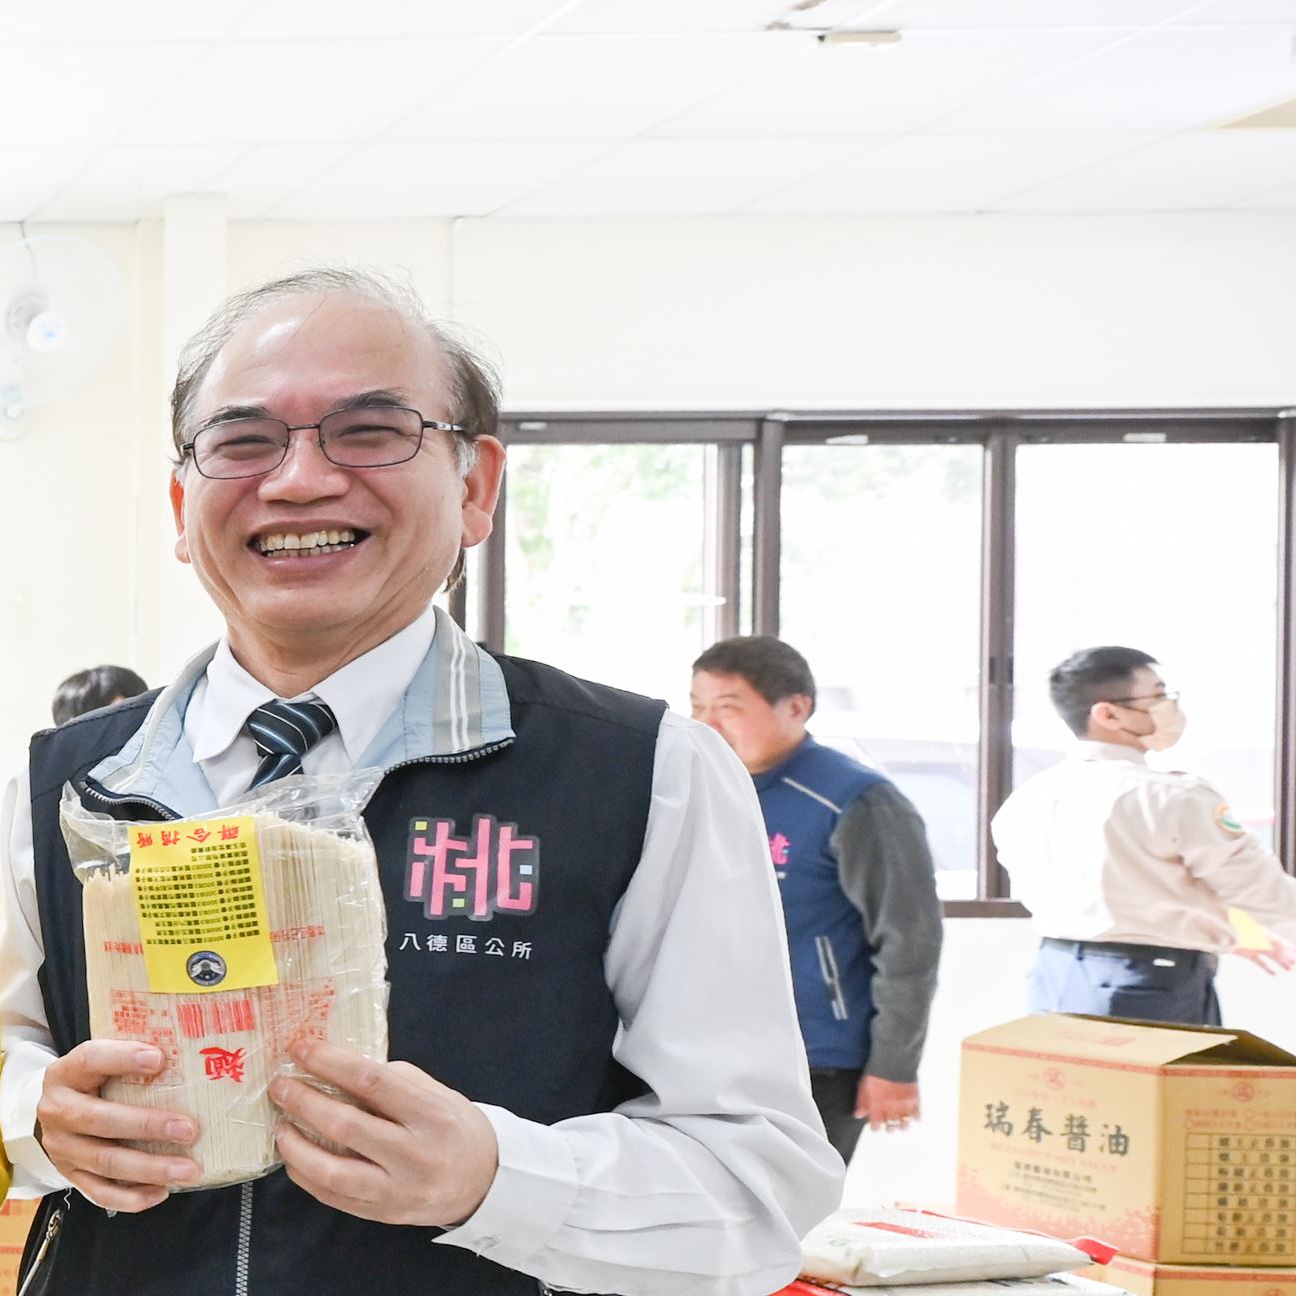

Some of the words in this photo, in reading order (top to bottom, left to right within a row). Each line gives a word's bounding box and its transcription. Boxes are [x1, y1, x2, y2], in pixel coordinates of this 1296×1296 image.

[399, 933, 533, 960] 八德區公所
[984, 1101, 1130, 1156] 瑞春醬油
